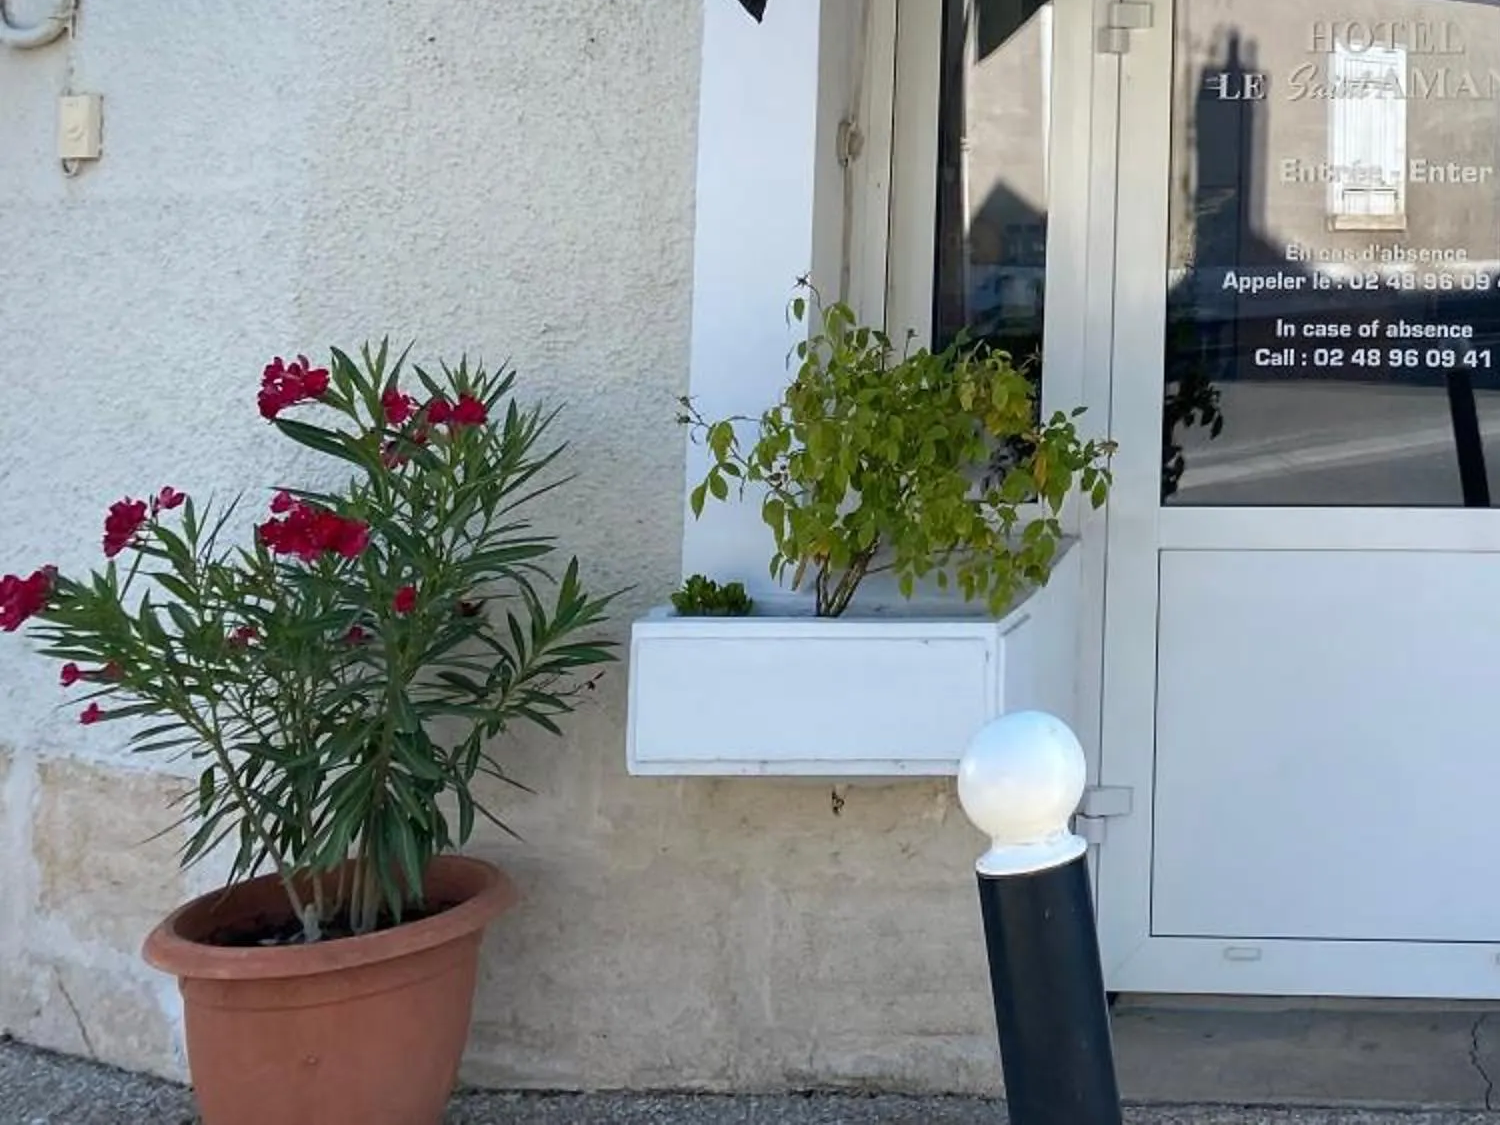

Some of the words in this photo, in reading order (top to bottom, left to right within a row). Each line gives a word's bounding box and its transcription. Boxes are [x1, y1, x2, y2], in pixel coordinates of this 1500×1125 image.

[1305, 19, 1466, 55] HOTEL
[1217, 73, 1267, 101] LE
[1287, 62, 1380, 102] Saint
[1409, 158, 1493, 183] Enter
[1285, 243, 1311, 262] En
[1319, 246, 1355, 262] cas
[1363, 243, 1467, 262] d'absence
[1222, 271, 1306, 293] Appeler
[1313, 271, 1331, 290] le
[1349, 273, 1379, 291] 02
[1386, 273, 1416, 291] 48
[1276, 320, 1295, 338] In
[1303, 324, 1351, 338] case
[1358, 320, 1378, 338] of
[1386, 320, 1473, 339] absence
[1254, 348, 1295, 367] Call
[1314, 349, 1343, 367] 02
[1351, 349, 1381, 367] 48
[1389, 349, 1418, 367] 96
[1426, 349, 1455, 367] 09
[1463, 349, 1492, 368] 41
